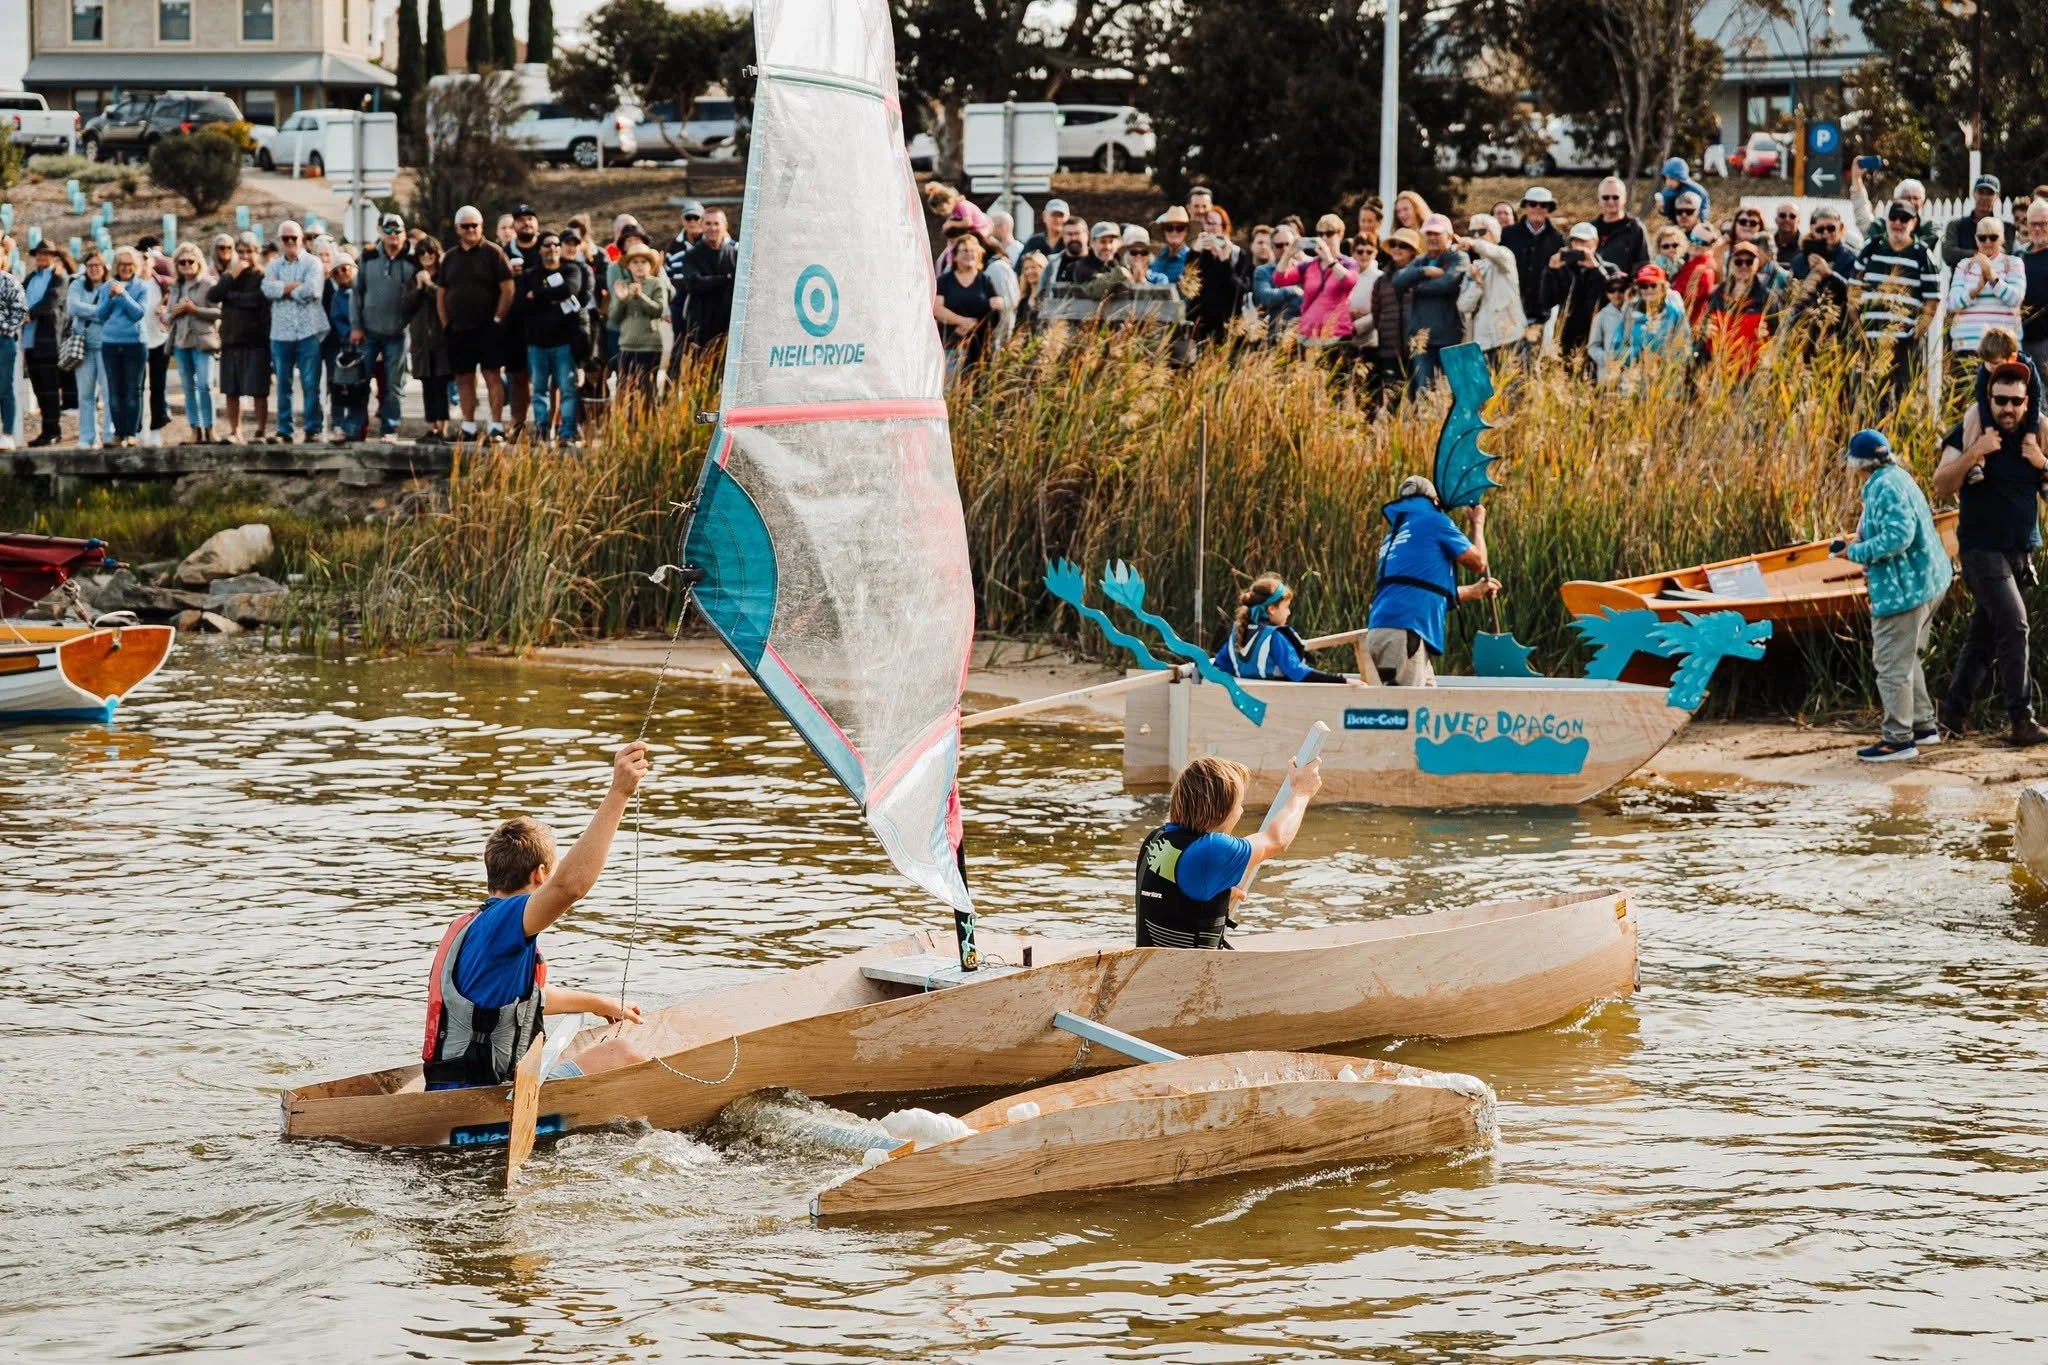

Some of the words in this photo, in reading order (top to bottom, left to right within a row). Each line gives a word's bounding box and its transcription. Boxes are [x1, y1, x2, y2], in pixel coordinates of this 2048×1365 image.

[1817, 129, 1831, 148] P
[769, 342, 865, 368] NEILPRYDE
[1415, 706, 1489, 741] RIVER
[1497, 710, 1584, 740] DRAGON
